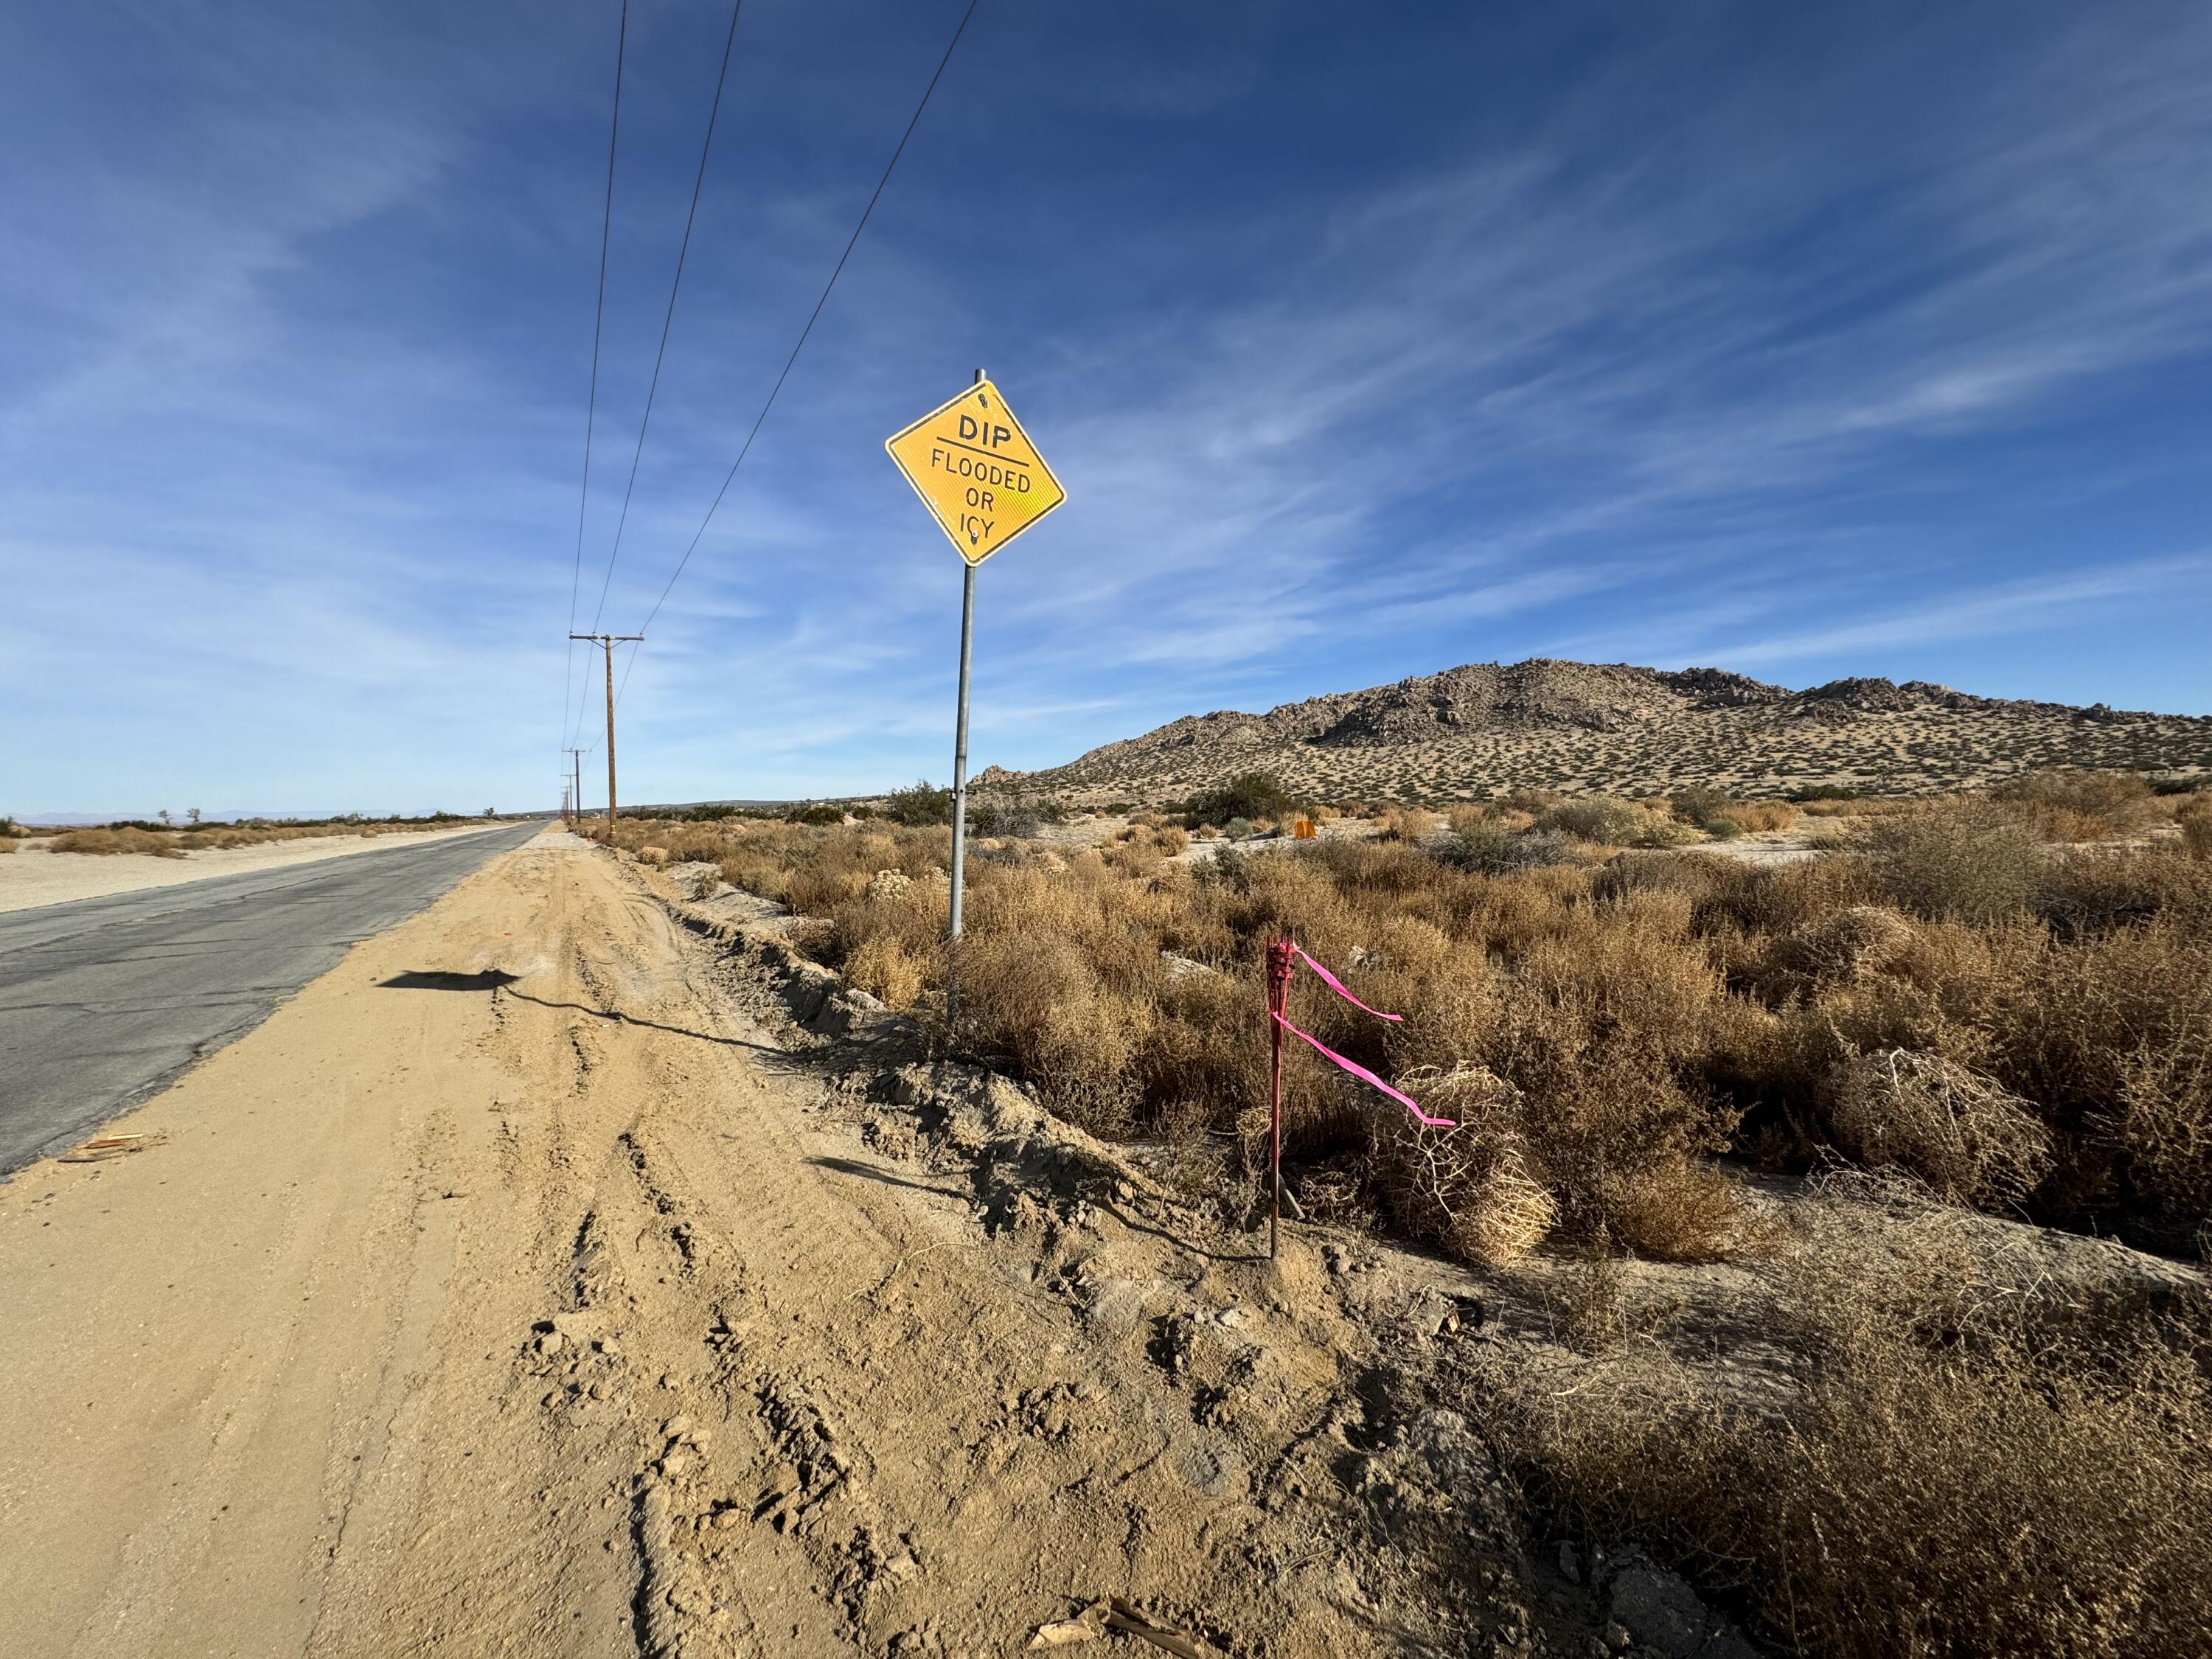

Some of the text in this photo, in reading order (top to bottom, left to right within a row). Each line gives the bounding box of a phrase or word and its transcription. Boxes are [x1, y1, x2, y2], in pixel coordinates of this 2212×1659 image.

[959, 414, 1012, 448] DIP
[931, 448, 1031, 493] FLOODED
[966, 487, 994, 512] OR
[960, 513, 995, 538] ICY
